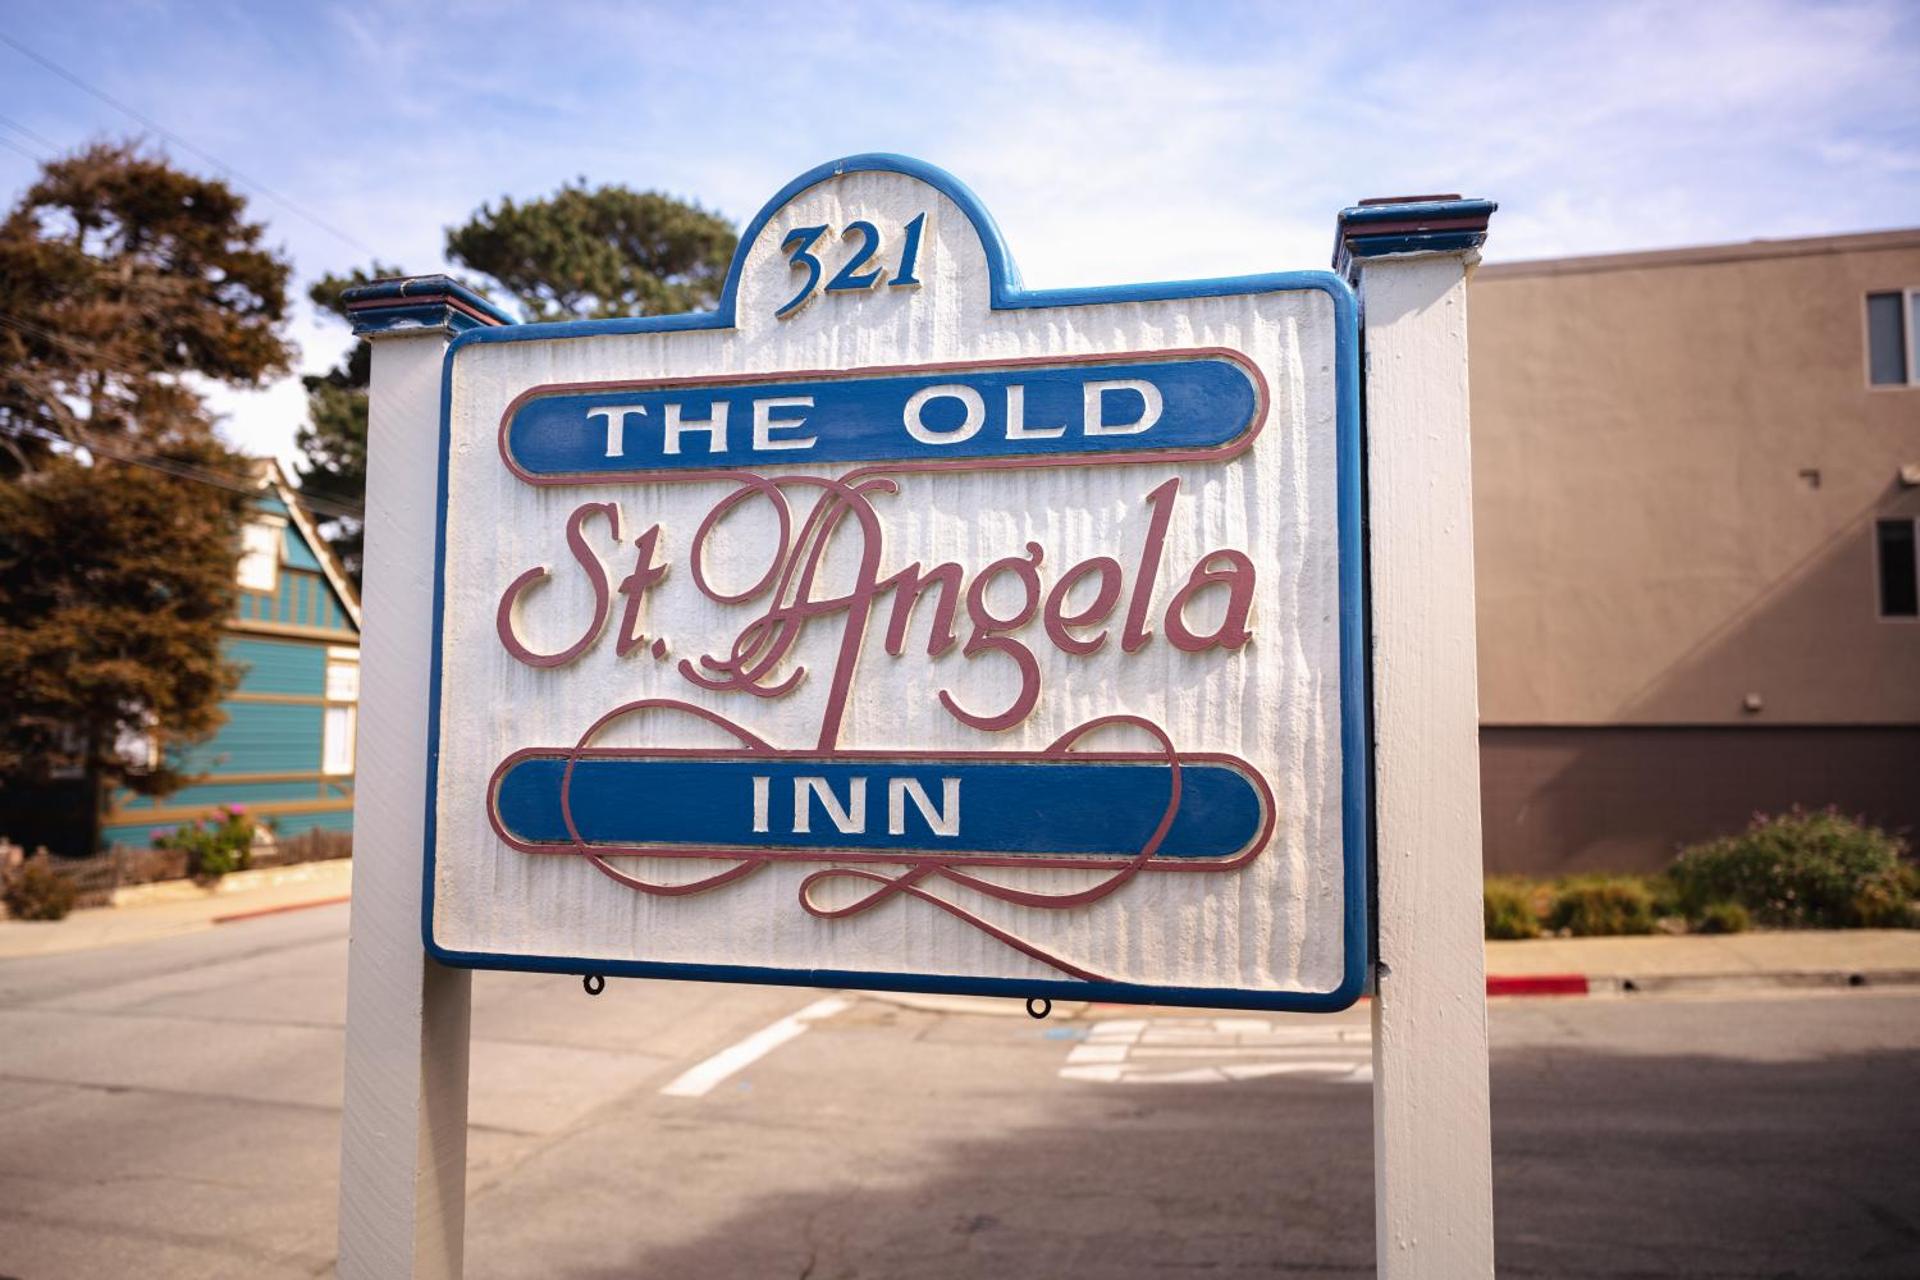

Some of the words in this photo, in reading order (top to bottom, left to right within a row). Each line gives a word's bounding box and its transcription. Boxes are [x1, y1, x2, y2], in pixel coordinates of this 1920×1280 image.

[774, 211, 928, 319] 321
[586, 396, 817, 457] THE
[902, 379, 1163, 444] OLD
[496, 502, 671, 669] St.
[679, 474, 1257, 750] Angela
[752, 775, 962, 837] INN
